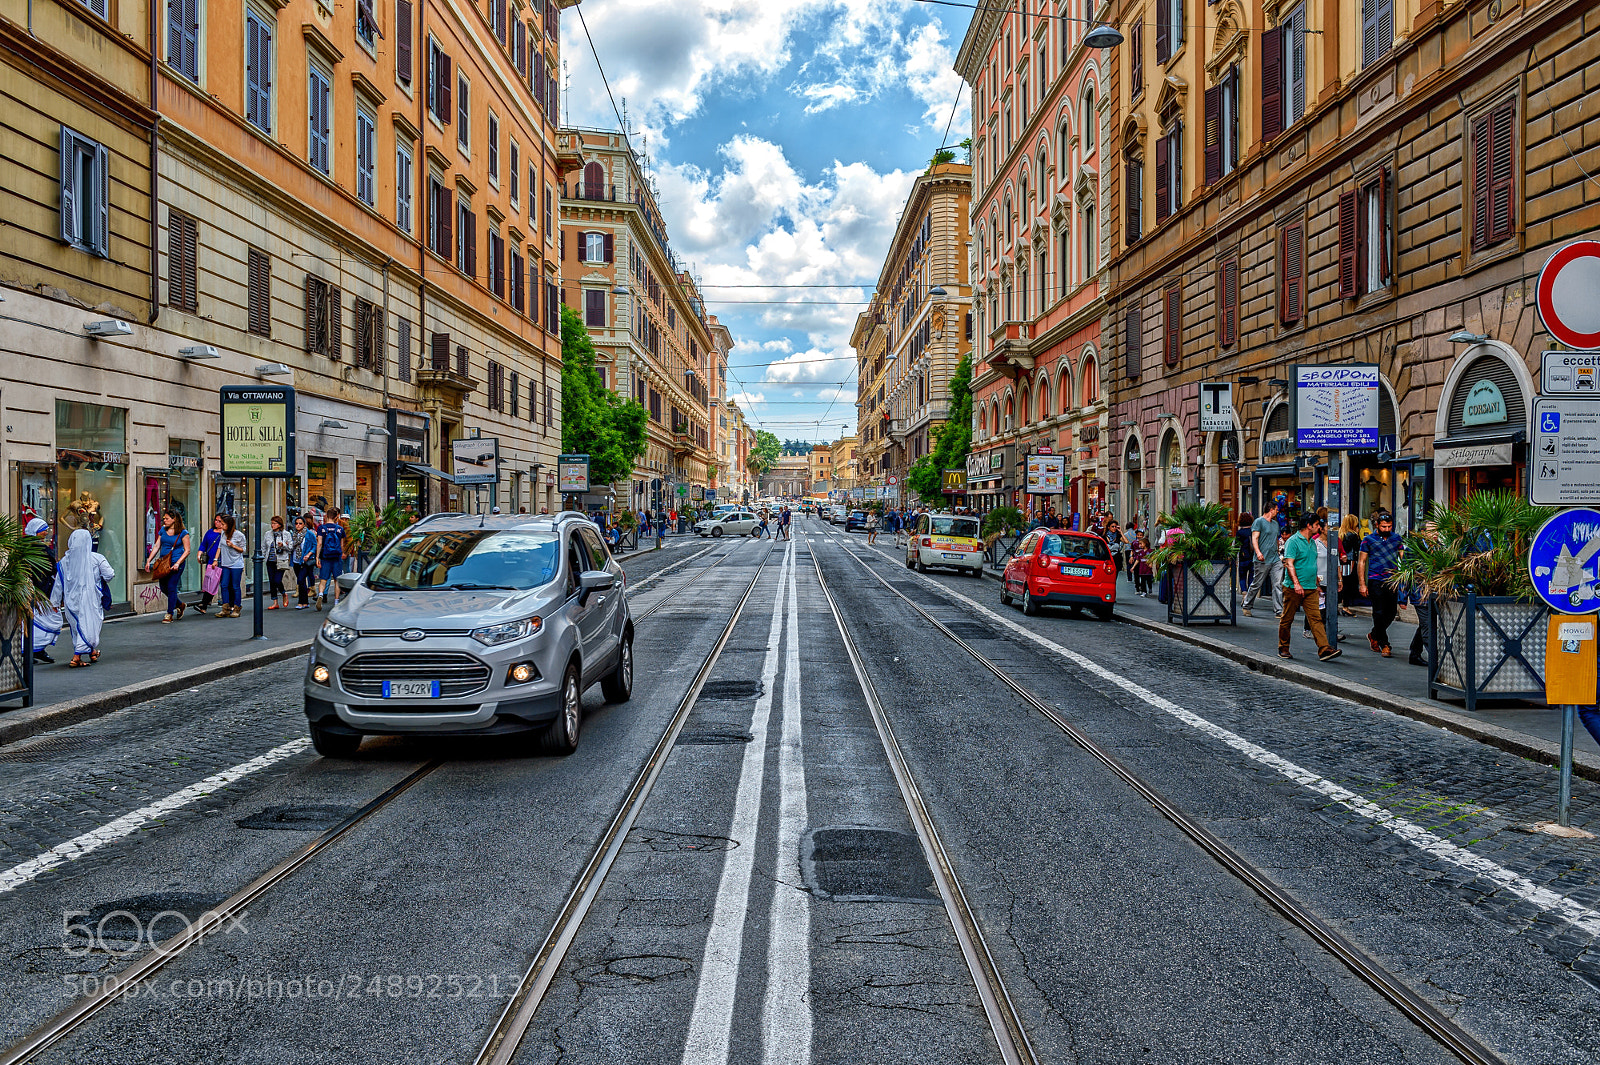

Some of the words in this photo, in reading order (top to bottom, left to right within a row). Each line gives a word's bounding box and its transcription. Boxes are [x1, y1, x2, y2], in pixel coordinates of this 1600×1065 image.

[1203, 384, 1229, 414] T
[1468, 402, 1500, 416] CORSANI
[226, 426, 256, 441] HOTEL
[259, 426, 284, 441] SILLA
[1448, 446, 1496, 460] Stilograph
